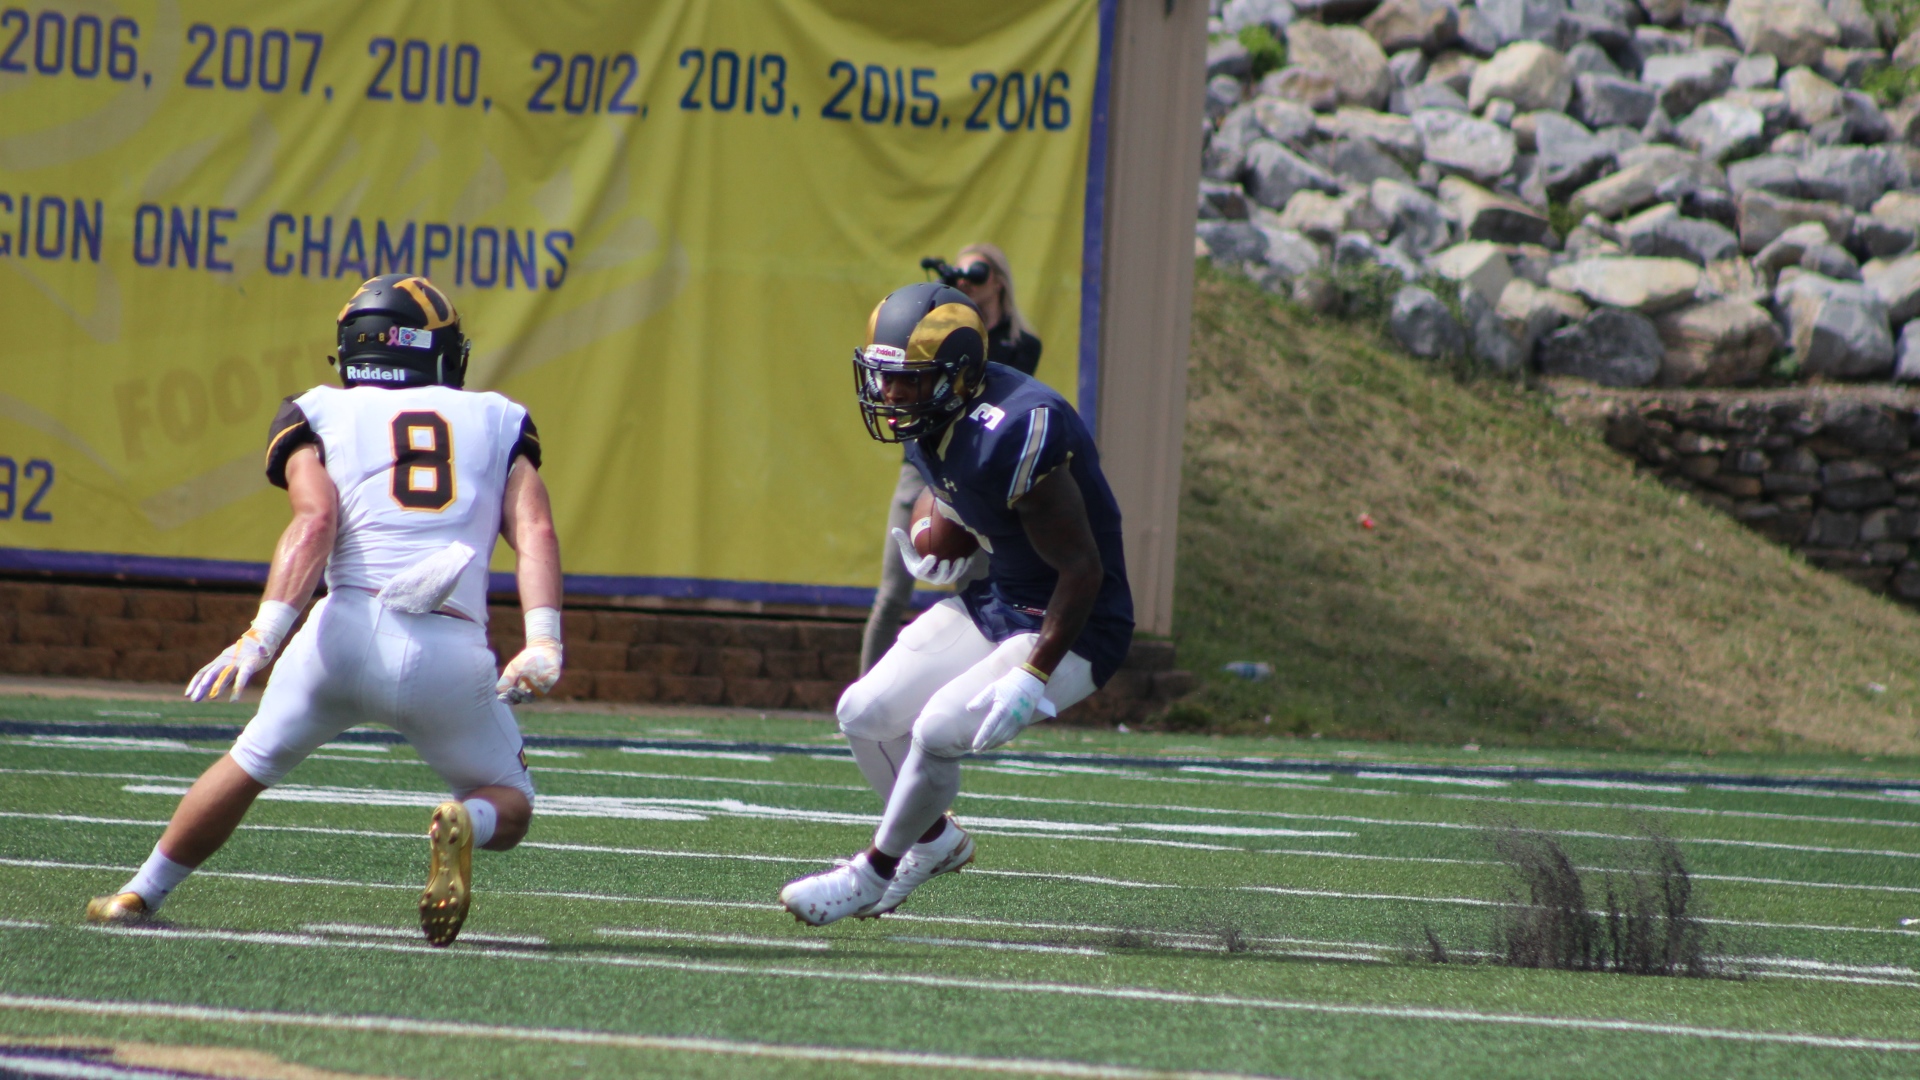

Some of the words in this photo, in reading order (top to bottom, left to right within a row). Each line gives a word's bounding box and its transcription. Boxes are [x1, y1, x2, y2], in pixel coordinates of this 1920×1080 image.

[0, 9, 152, 89] 2006,
[184, 23, 334, 102] 2007,
[366, 37, 492, 113] 2010,
[527, 52, 648, 119] 2012,
[678, 49, 799, 120] 2013,
[964, 70, 1071, 132] 2016
[133, 202, 237, 272] ONE
[265, 212, 575, 291] CHAMPIONS
[346, 365, 405, 381] Riddell
[969, 402, 1006, 431] 3
[388, 409, 457, 514] 8
